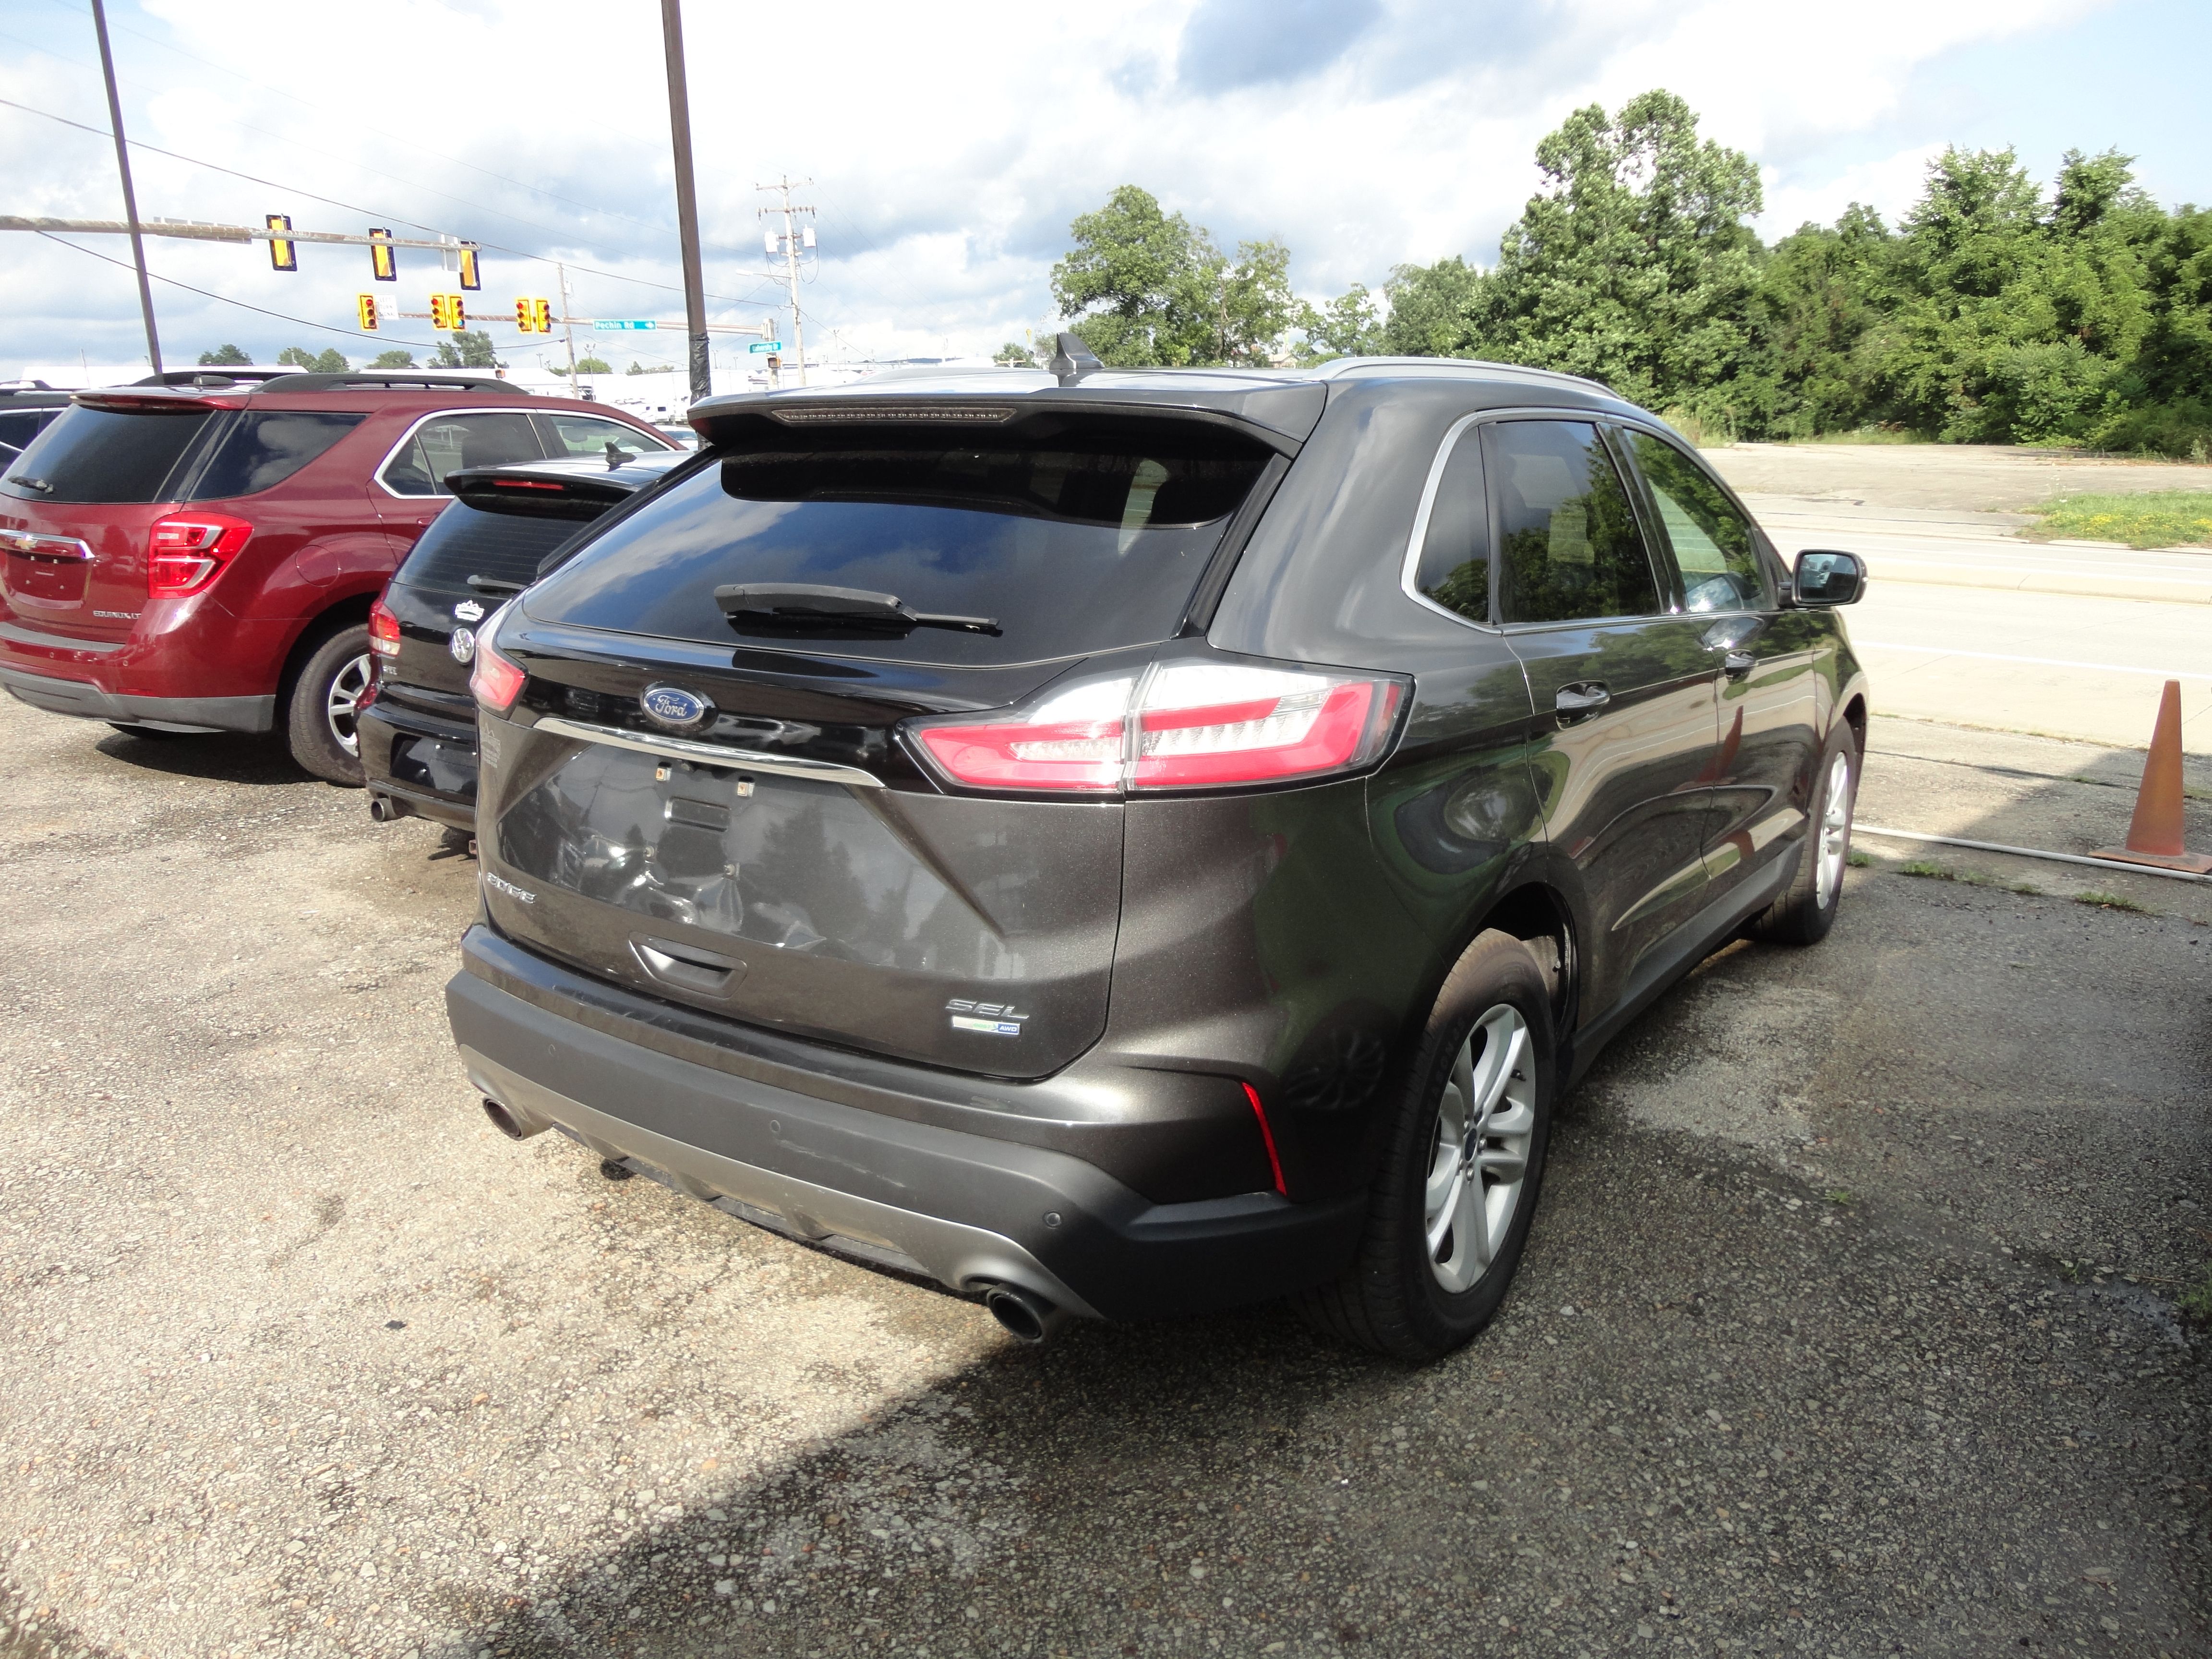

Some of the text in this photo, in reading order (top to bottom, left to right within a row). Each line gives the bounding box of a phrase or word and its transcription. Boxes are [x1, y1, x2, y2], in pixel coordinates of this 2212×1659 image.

[595, 321, 635, 329] Pechin Rd
[93, 610, 131, 619] EQUINOX
[655, 694, 688, 717] Ford
[487, 872, 537, 904] EDGE
[945, 998, 1030, 1020] SEL
